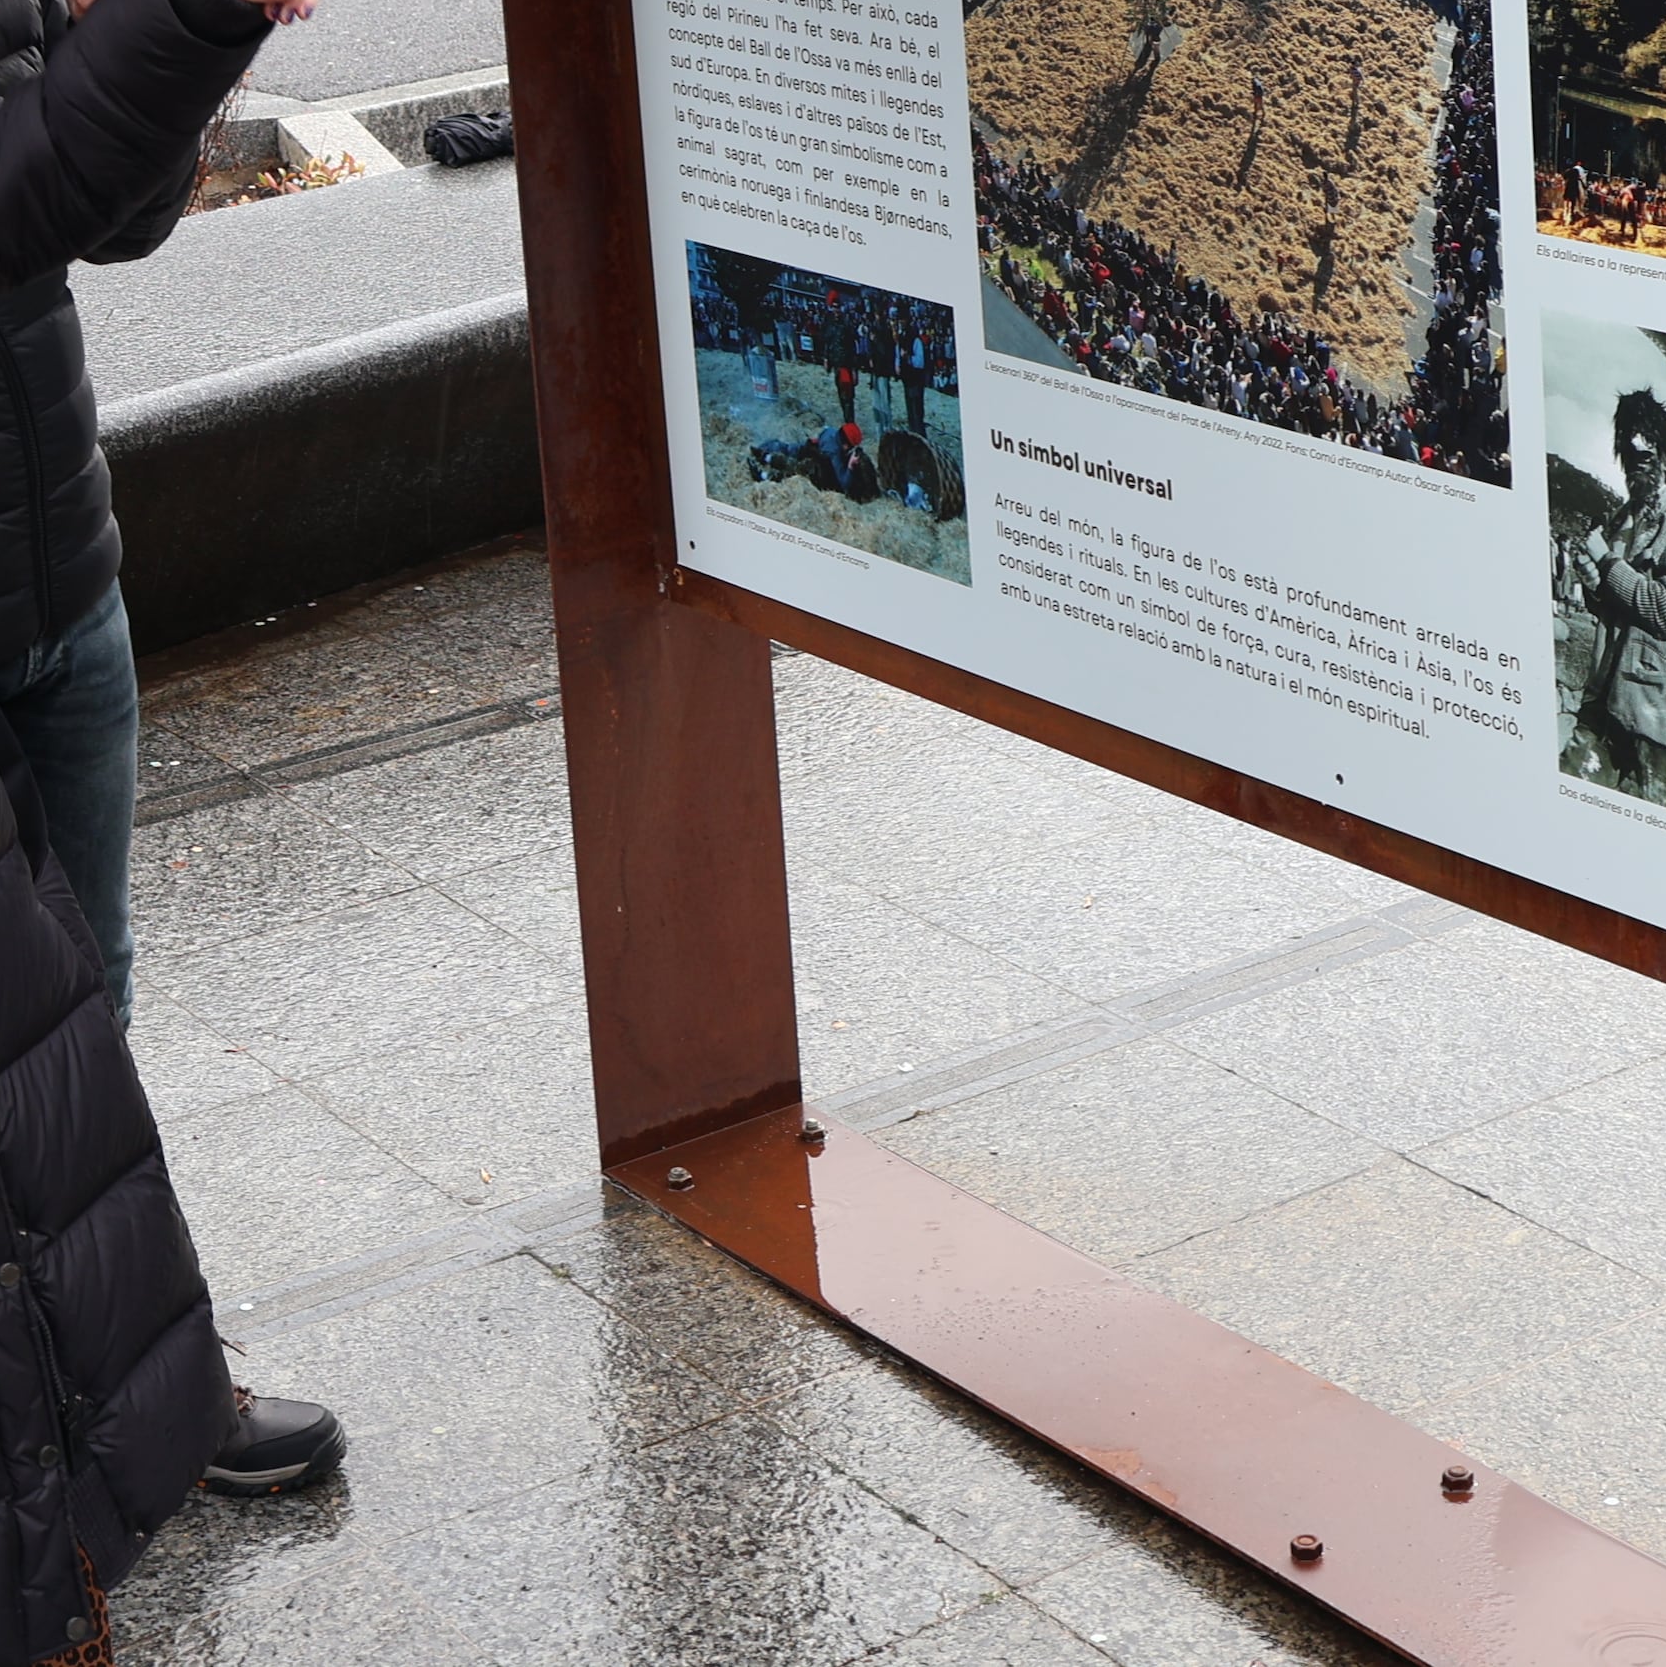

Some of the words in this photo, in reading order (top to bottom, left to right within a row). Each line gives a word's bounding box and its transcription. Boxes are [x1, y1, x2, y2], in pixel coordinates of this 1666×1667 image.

[1537, 243, 1551, 258] Els
[1552, 247, 1597, 267] dallaires
[1607, 258, 1617, 270] la
[991, 429, 1014, 454] Un
[1018, 438, 1080, 473] símbol
[1084, 460, 1172, 500] universal
[995, 493, 1032, 517] Arreu
[1039, 507, 1061, 526] del
[1069, 519, 1104, 543] món,
[1111, 528, 1123, 546] la
[1130, 534, 1175, 563] figura
[1183, 552, 1202, 571] de
[1210, 558, 1236, 582] l'os
[1244, 574, 1278, 595] està
[1287, 587, 1407, 636] profundament
[1416, 627, 1488, 661] arrelada
[1498, 653, 1520, 671] en
[997, 520, 1063, 556] llegendes
[1069, 543, 1072, 559] i
[1079, 548, 1127, 577] rituals.
[1134, 565, 1151, 585] En
[1158, 571, 1179, 593] les
[1185, 585, 1248, 616] cultures
[1255, 605, 1341, 649] d'Amèrica,
[1348, 629, 1397, 664] Àfrica
[1405, 650, 1408, 668] i
[1416, 651, 1456, 686] Àsia,
[1464, 670, 1493, 695] l'os
[1501, 682, 1521, 704] és
[999, 554, 1073, 588] considerat
[1079, 580, 1110, 601] com
[1117, 592, 1135, 609] un
[1141, 598, 1190, 627] símbol
[1197, 616, 1216, 635] de
[1222, 623, 1268, 656] força,
[1275, 645, 1315, 672] cura,
[1323, 660, 1413, 701] resistència
[1421, 688, 1425, 705] i
[1433, 696, 1523, 740] protecció,
[1001, 583, 1031, 602] amb
[1034, 594, 1060, 612] una
[1063, 604, 1115, 631] estreta
[1118, 622, 1168, 649] relació
[1172, 640, 1205, 661] amb
[1209, 648, 1222, 668] la
[1226, 659, 1277, 686] natura
[1281, 672, 1285, 689] i
[1289, 678, 1302, 695] el
[1307, 686, 1342, 709] món
[1347, 700, 1429, 738] espiritual.
